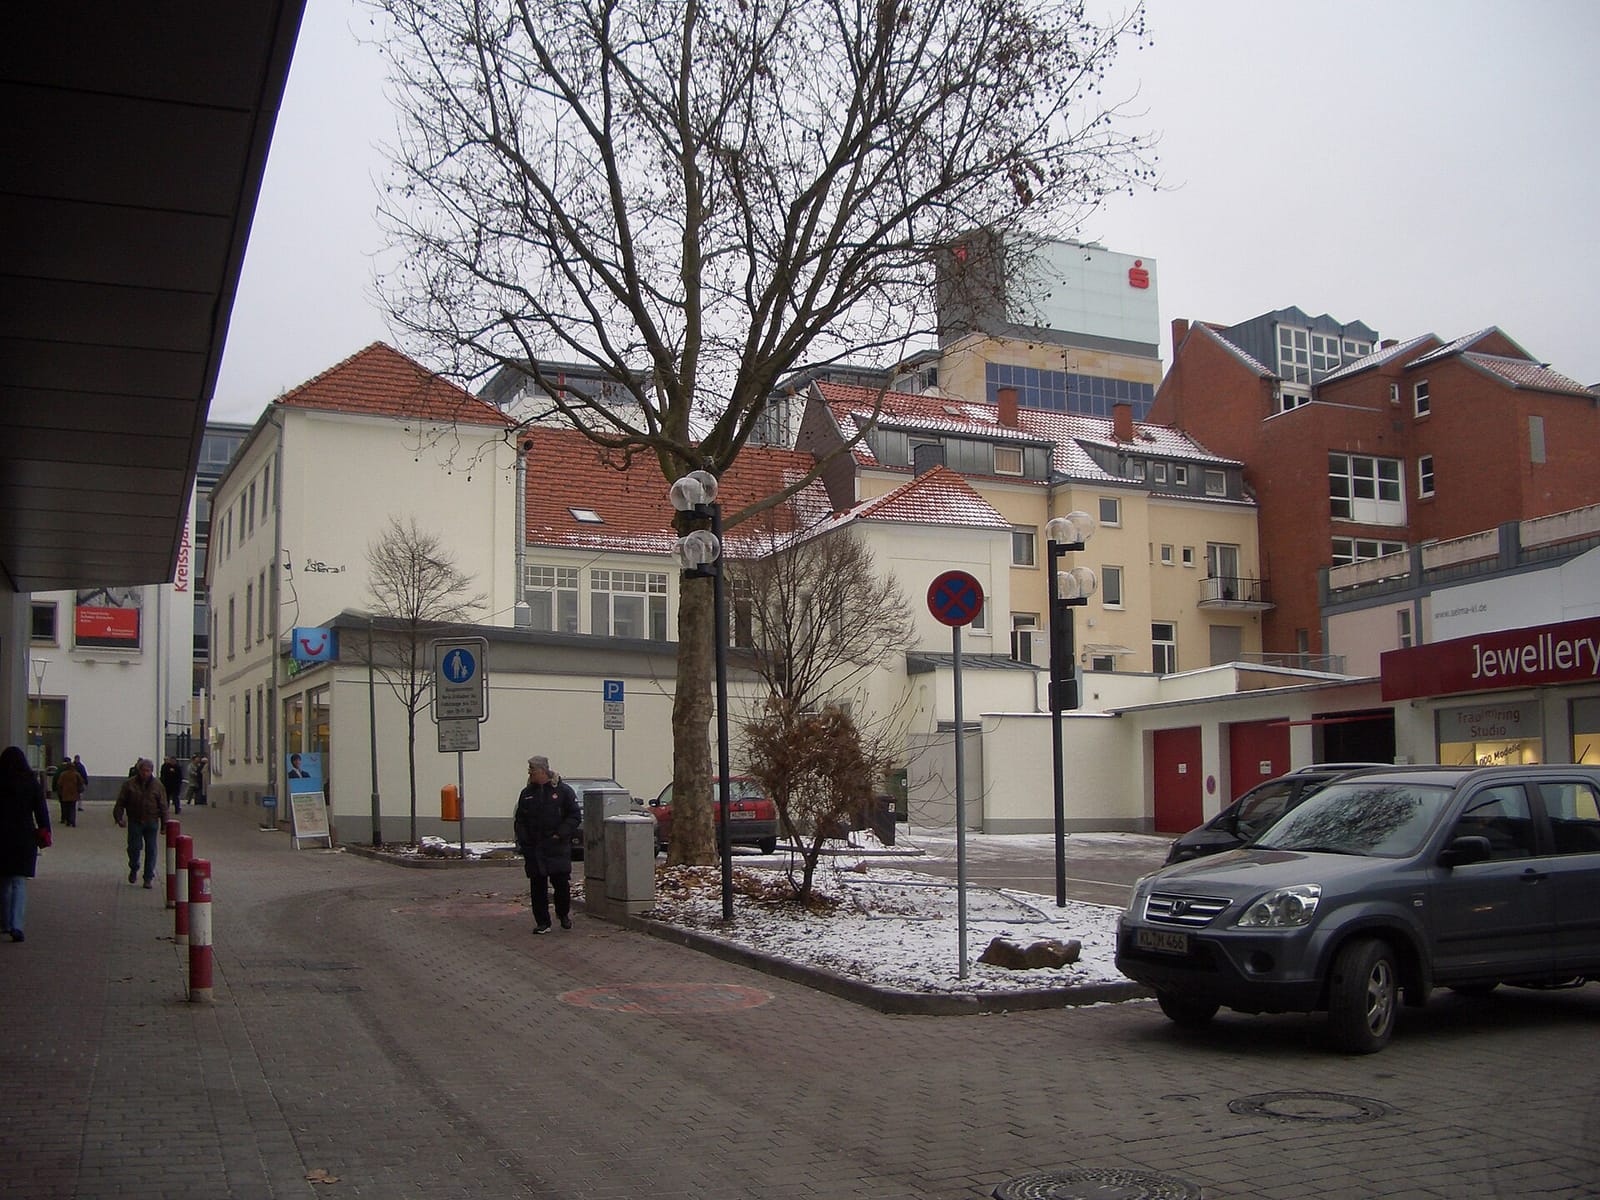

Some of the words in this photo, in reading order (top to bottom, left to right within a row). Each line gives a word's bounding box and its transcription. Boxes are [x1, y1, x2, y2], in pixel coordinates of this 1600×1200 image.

[173, 512, 192, 592] Kreisspa
[1471, 633, 1600, 679] Jewellery
[608, 682, 620, 700] P
[1471, 725, 1507, 738] Studio
